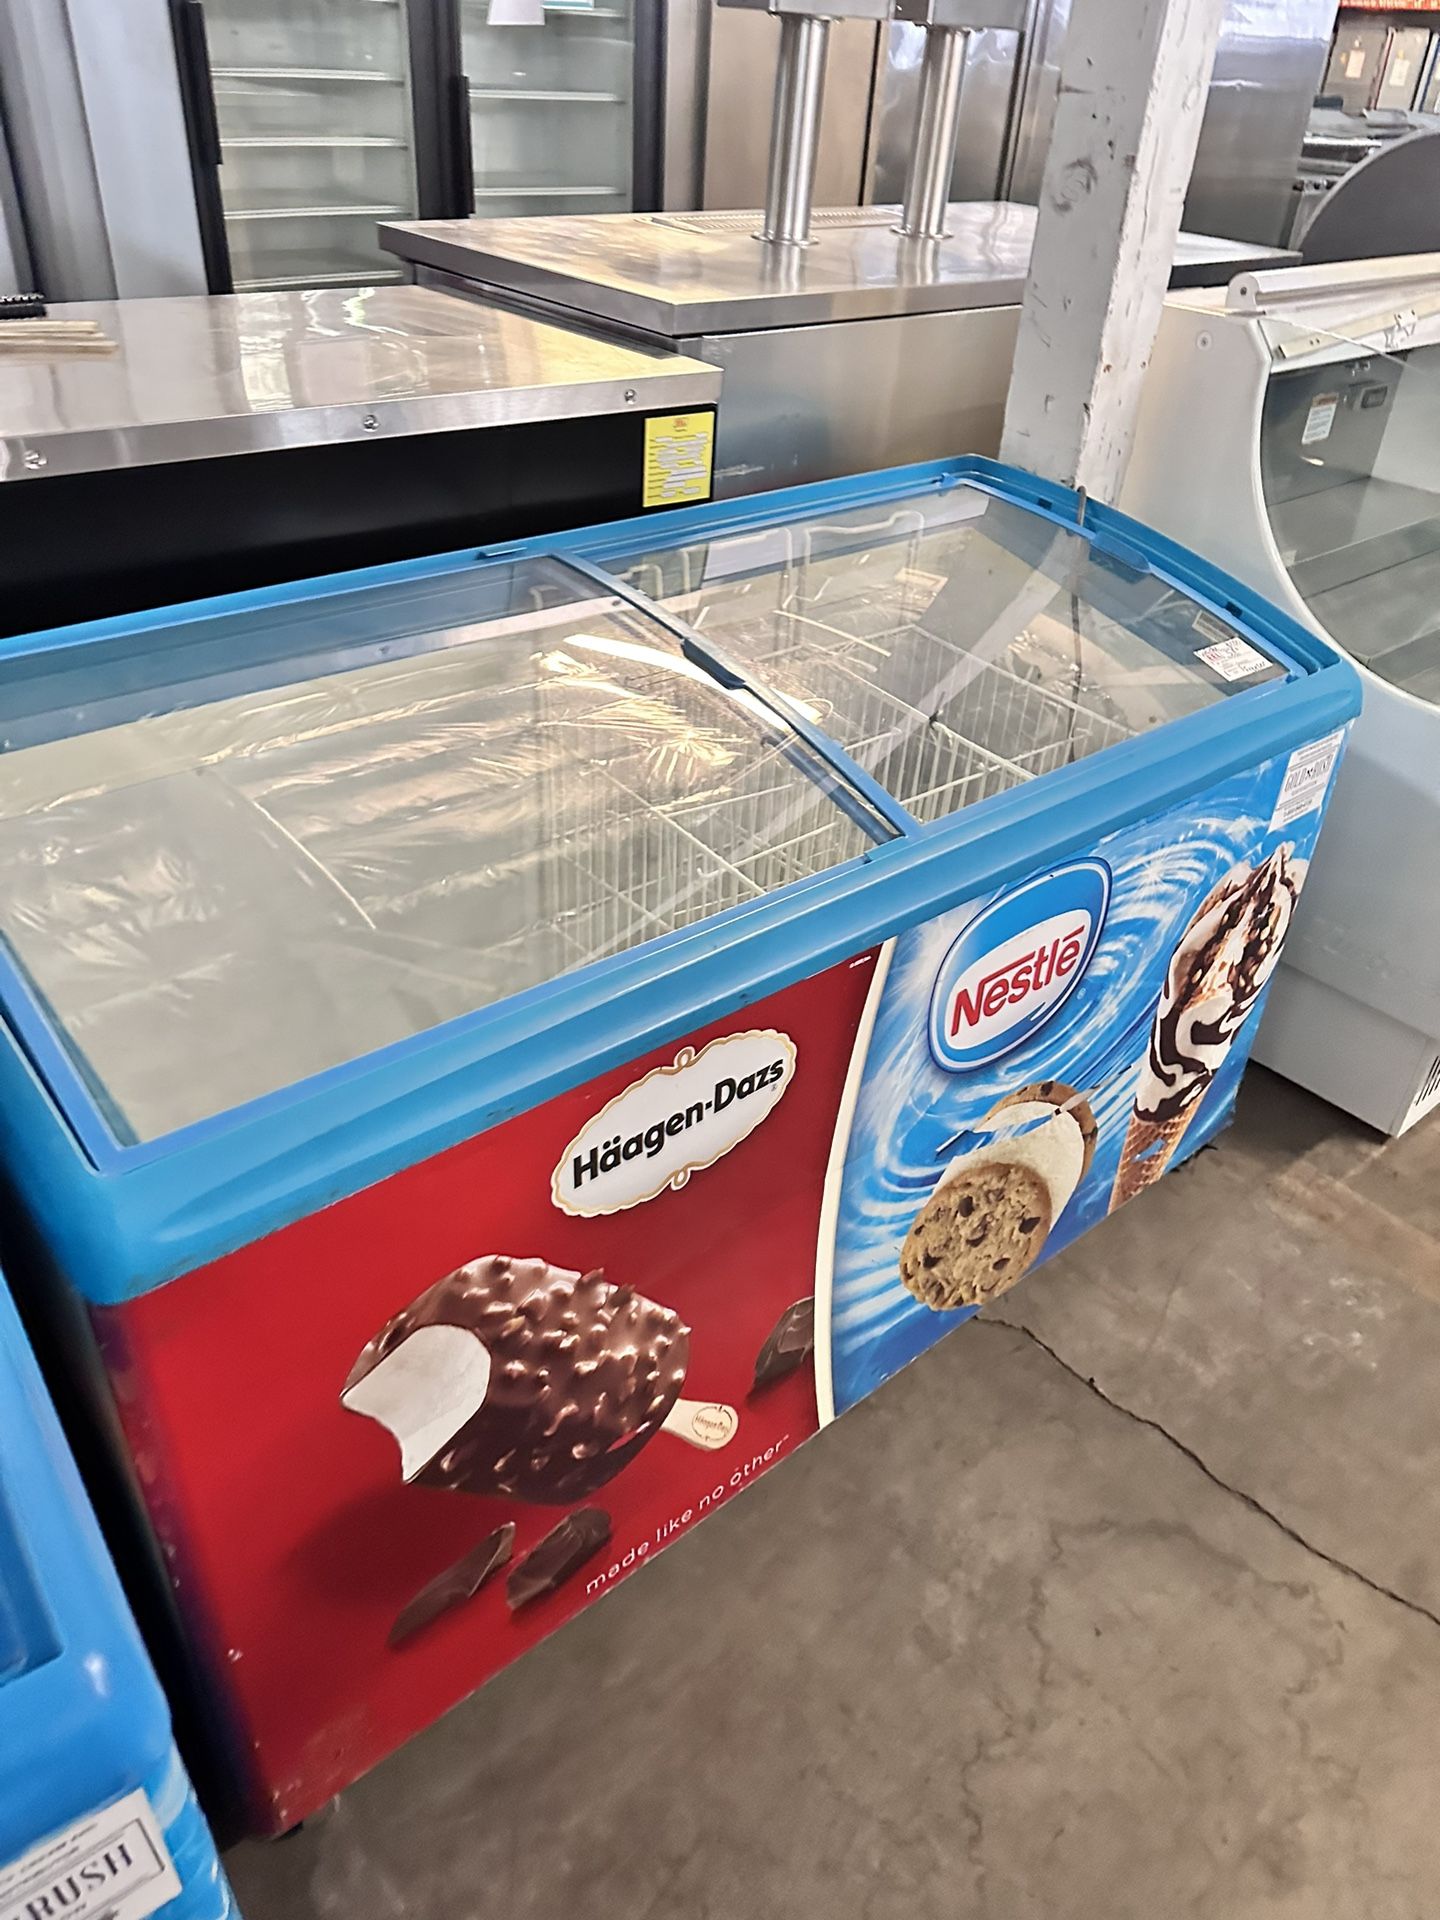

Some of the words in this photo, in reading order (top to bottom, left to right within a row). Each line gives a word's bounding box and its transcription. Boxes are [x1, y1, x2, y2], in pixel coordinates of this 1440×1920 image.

[951, 925, 1085, 1037] Nestlé
[573, 1059, 784, 1189] Häagen-Dazs
[586, 1541, 649, 1595] made
[656, 1508, 692, 1542] like
[699, 1485, 724, 1510] no
[730, 1439, 781, 1487] other
[26, 1843, 132, 1920] RUSH
